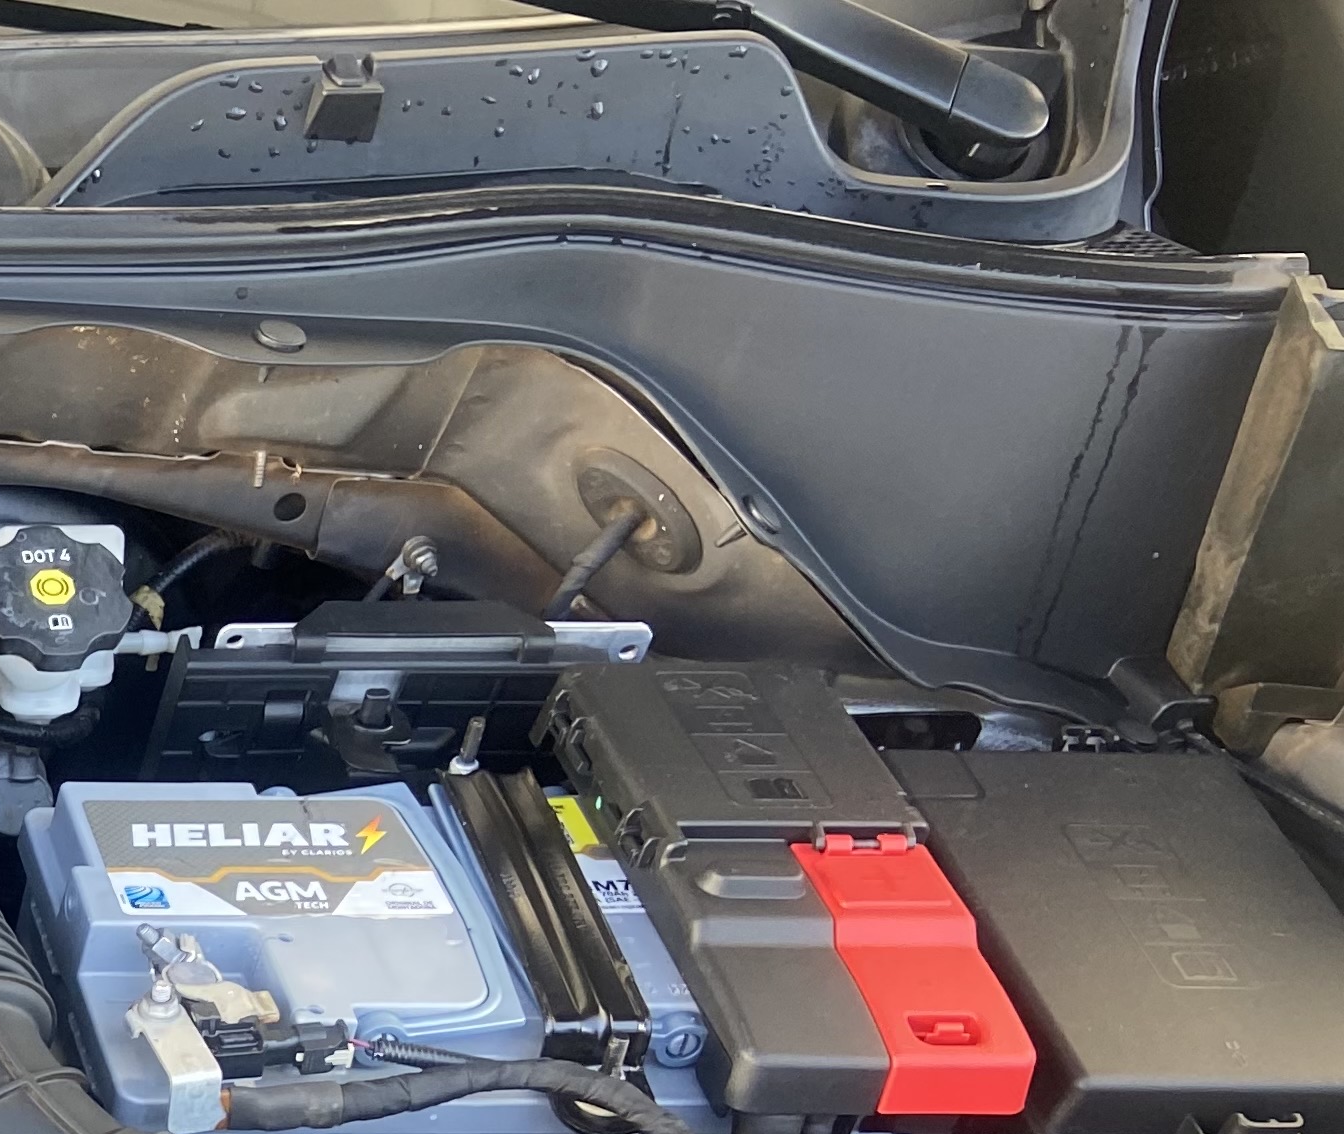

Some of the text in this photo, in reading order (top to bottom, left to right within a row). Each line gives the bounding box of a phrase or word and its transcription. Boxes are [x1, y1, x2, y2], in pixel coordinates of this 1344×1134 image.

[21, 548, 71, 564] DOT 4
[131, 822, 350, 848] HELIAR
[235, 880, 328, 901] AGM
[295, 901, 329, 909] TECH
